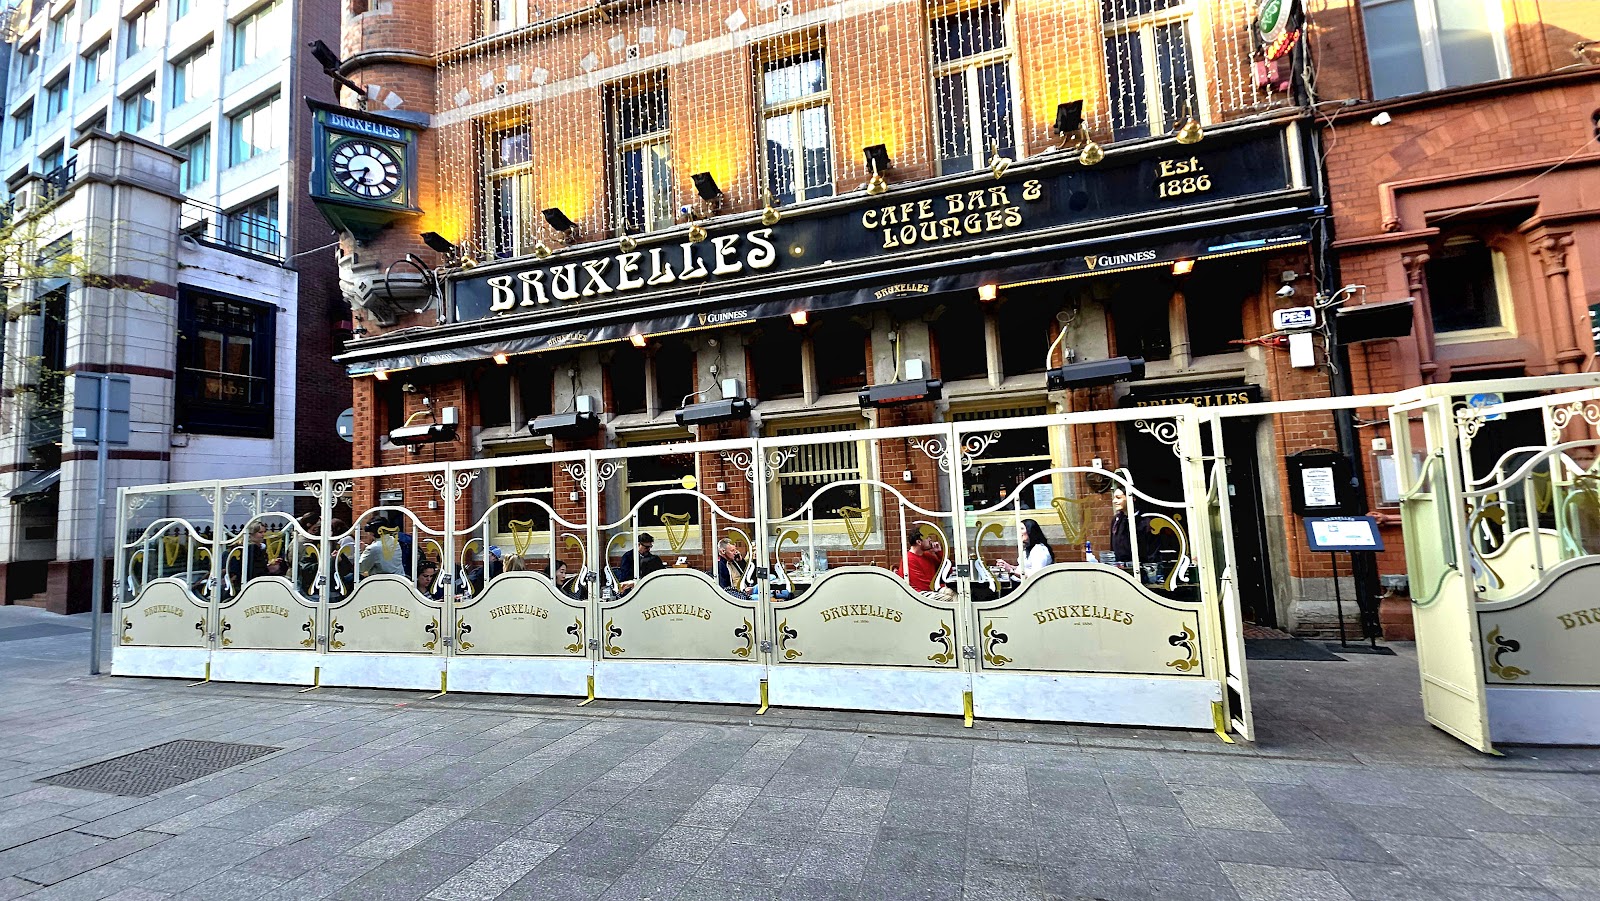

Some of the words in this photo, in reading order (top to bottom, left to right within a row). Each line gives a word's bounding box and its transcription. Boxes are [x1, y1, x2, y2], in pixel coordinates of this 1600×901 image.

[331, 113, 401, 138] BRUXELLES
[1159, 156, 1204, 177] Est.
[1159, 175, 1211, 198] 1886
[862, 199, 935, 229] CAFE
[945, 185, 1011, 214] BAR
[1022, 179, 1042, 200] &
[883, 206, 1023, 249] LOUNGES
[1098, 249, 1157, 267] GUINNESS
[487, 228, 776, 312] BRUXELLES
[874, 283, 930, 299] BRUXELLES
[707, 310, 748, 324] GUINNESS
[358, 604, 411, 619] BRUXELLES
[489, 604, 549, 620] BRUXELLES
[641, 604, 712, 621] BRUXELLES
[820, 604, 903, 623] BRUXELLES
[1033, 604, 1135, 626] BRUXELLES
